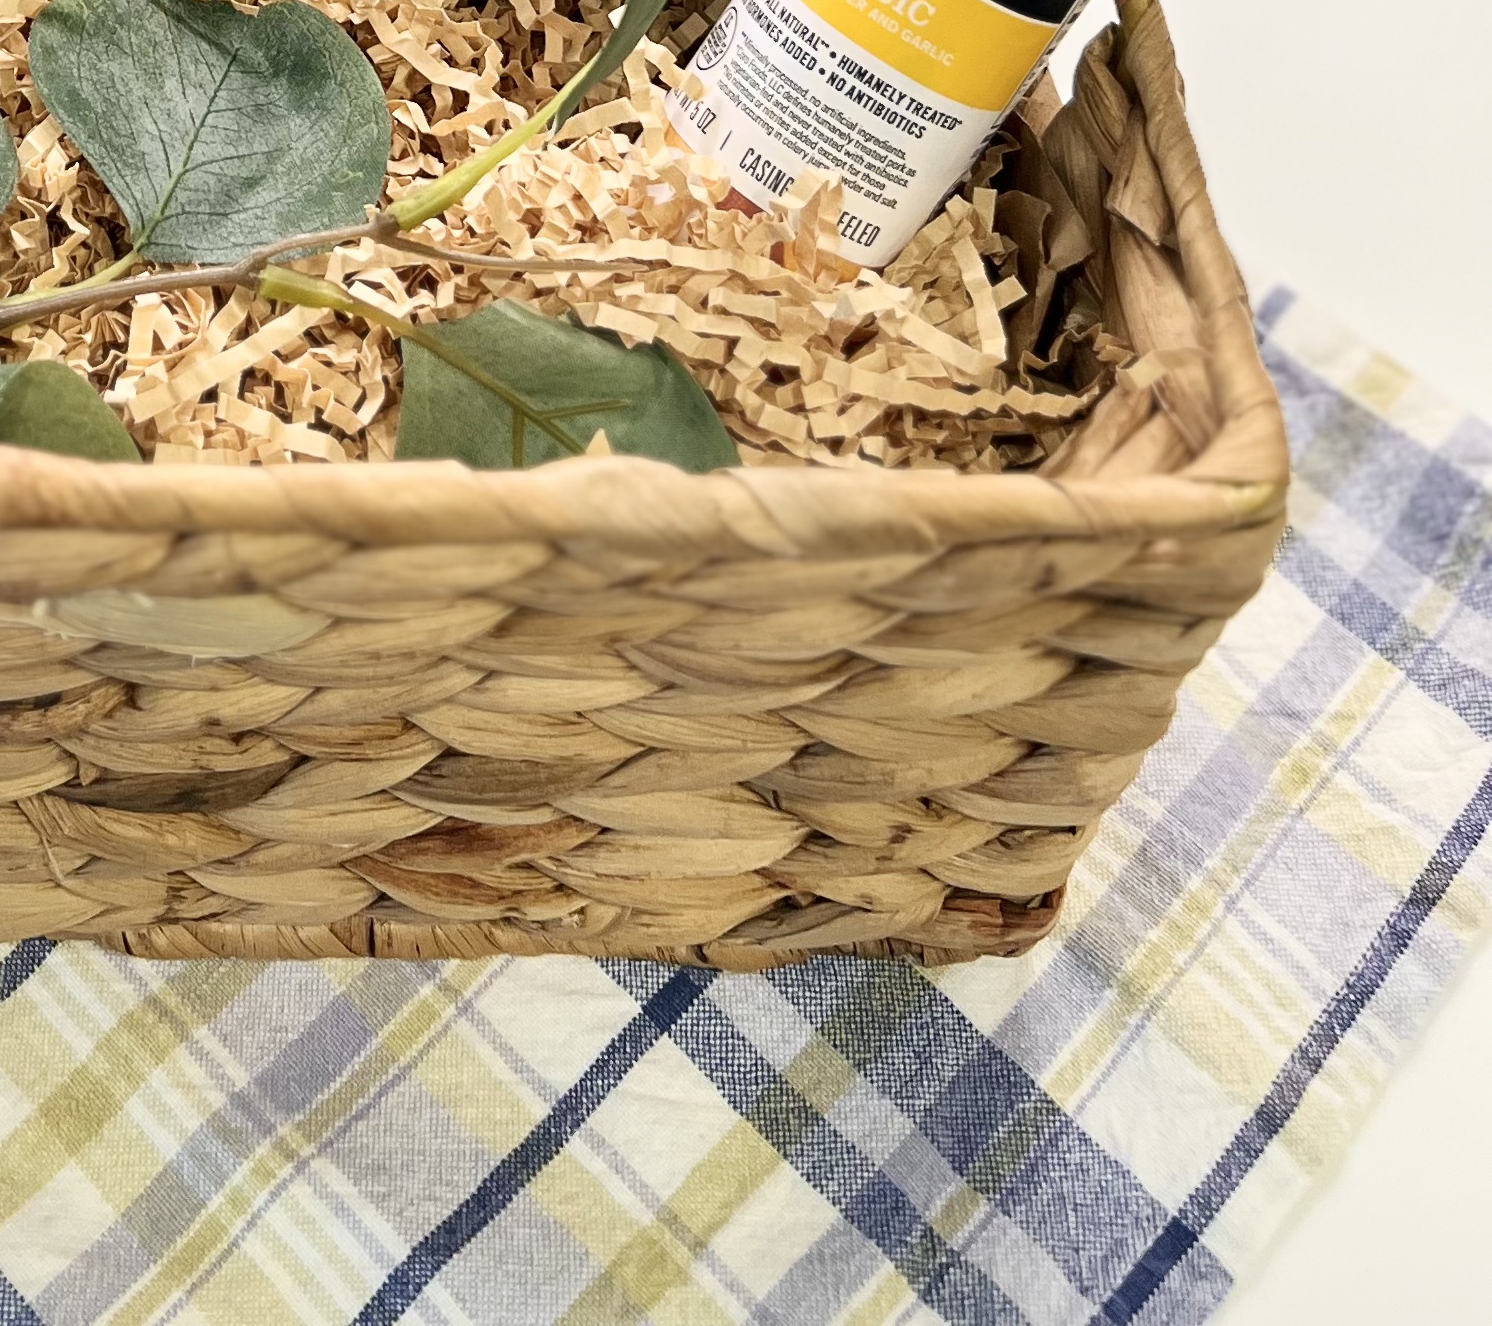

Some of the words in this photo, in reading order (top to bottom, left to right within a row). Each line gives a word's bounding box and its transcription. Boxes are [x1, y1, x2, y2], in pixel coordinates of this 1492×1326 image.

[868, 8, 899, 34] AND
[901, 29, 955, 67] GARLIC
[779, 36, 817, 71] ADDED
[826, 72, 846, 92] NO
[844, 85, 926, 139] ANTIBIOTICS
[838, 55, 906, 105] HUMANELY
[790, 128, 819, 150] added
[811, 127, 845, 152] treated
[812, 110, 853, 145] humanely
[841, 176, 865, 193] wder
[837, 211, 881, 247] EELED
